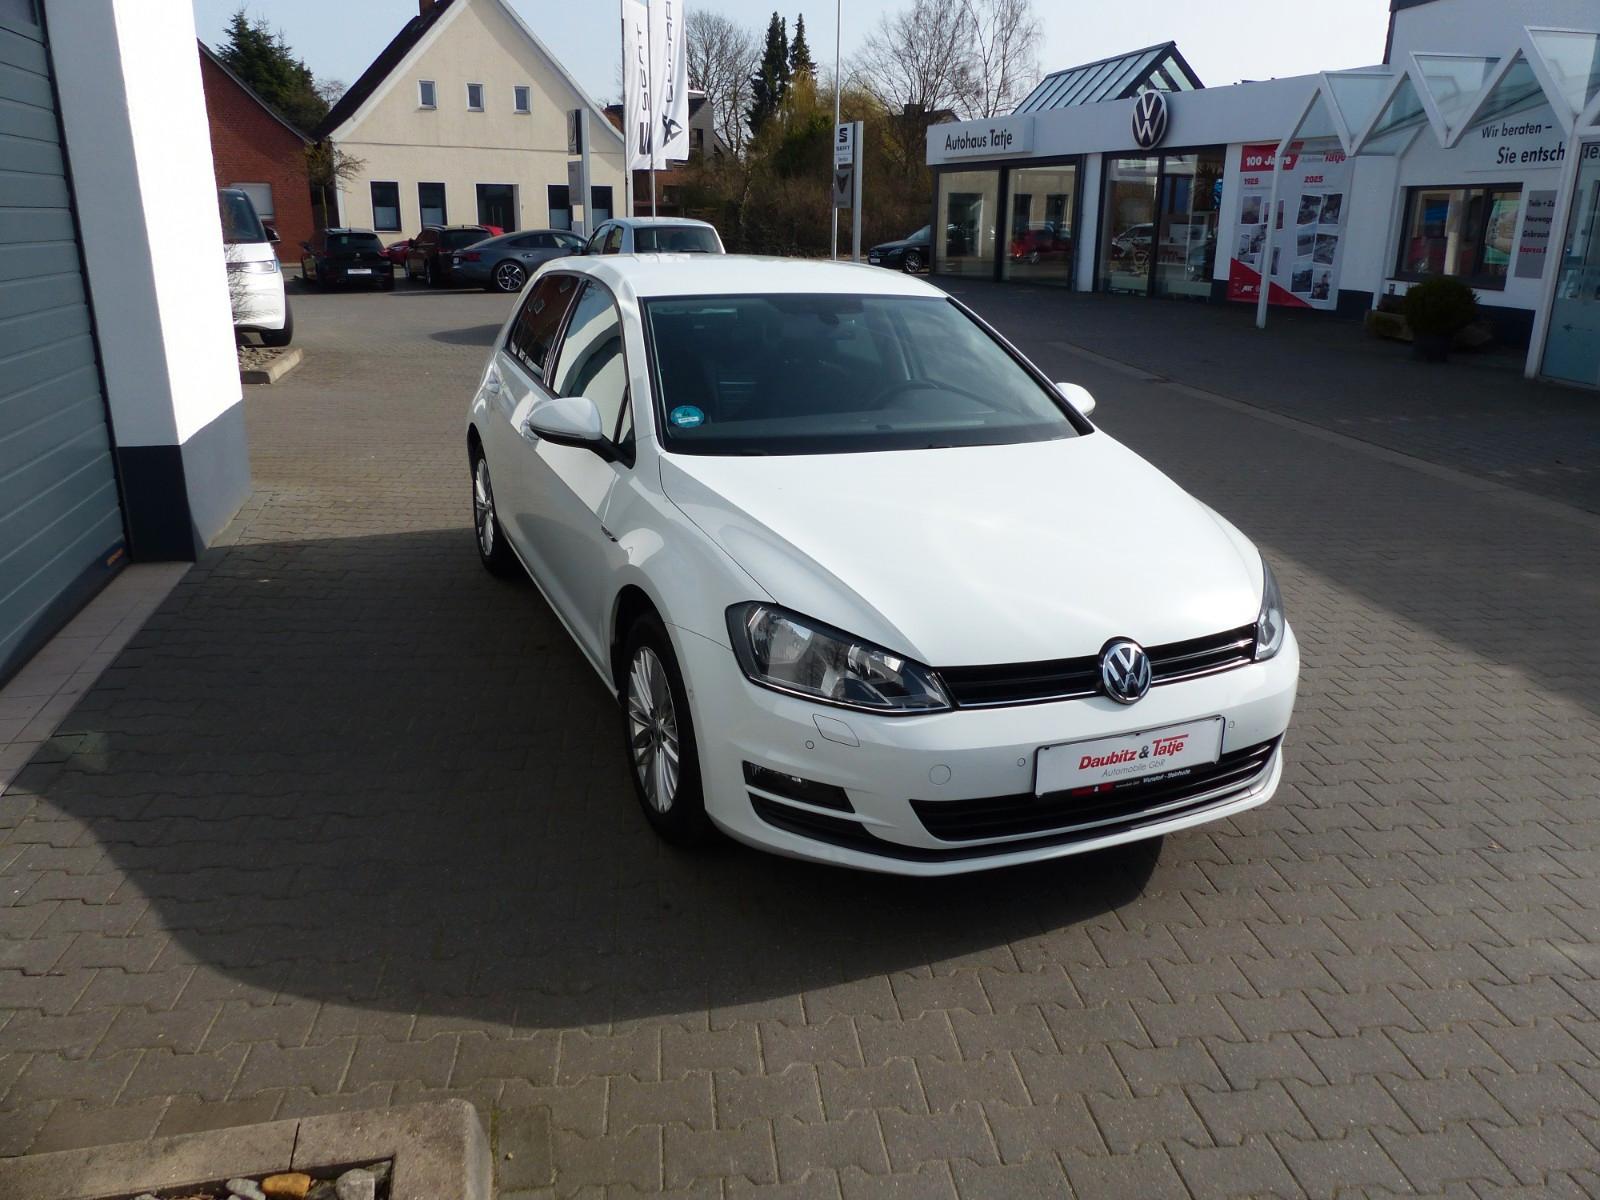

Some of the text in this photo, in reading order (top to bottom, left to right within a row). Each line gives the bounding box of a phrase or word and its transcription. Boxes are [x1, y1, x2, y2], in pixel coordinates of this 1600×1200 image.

[945, 127, 1013, 151] Autohaus Tatje
[1481, 127, 1498, 139] Wir
[1501, 122, 1542, 137] beraten
[1246, 156, 1262, 166] 100
[1496, 147, 1517, 164] Sie
[1078, 734, 1189, 770] Daubitz & Tatje
[1101, 758, 1166, 778] Automobile GbR
